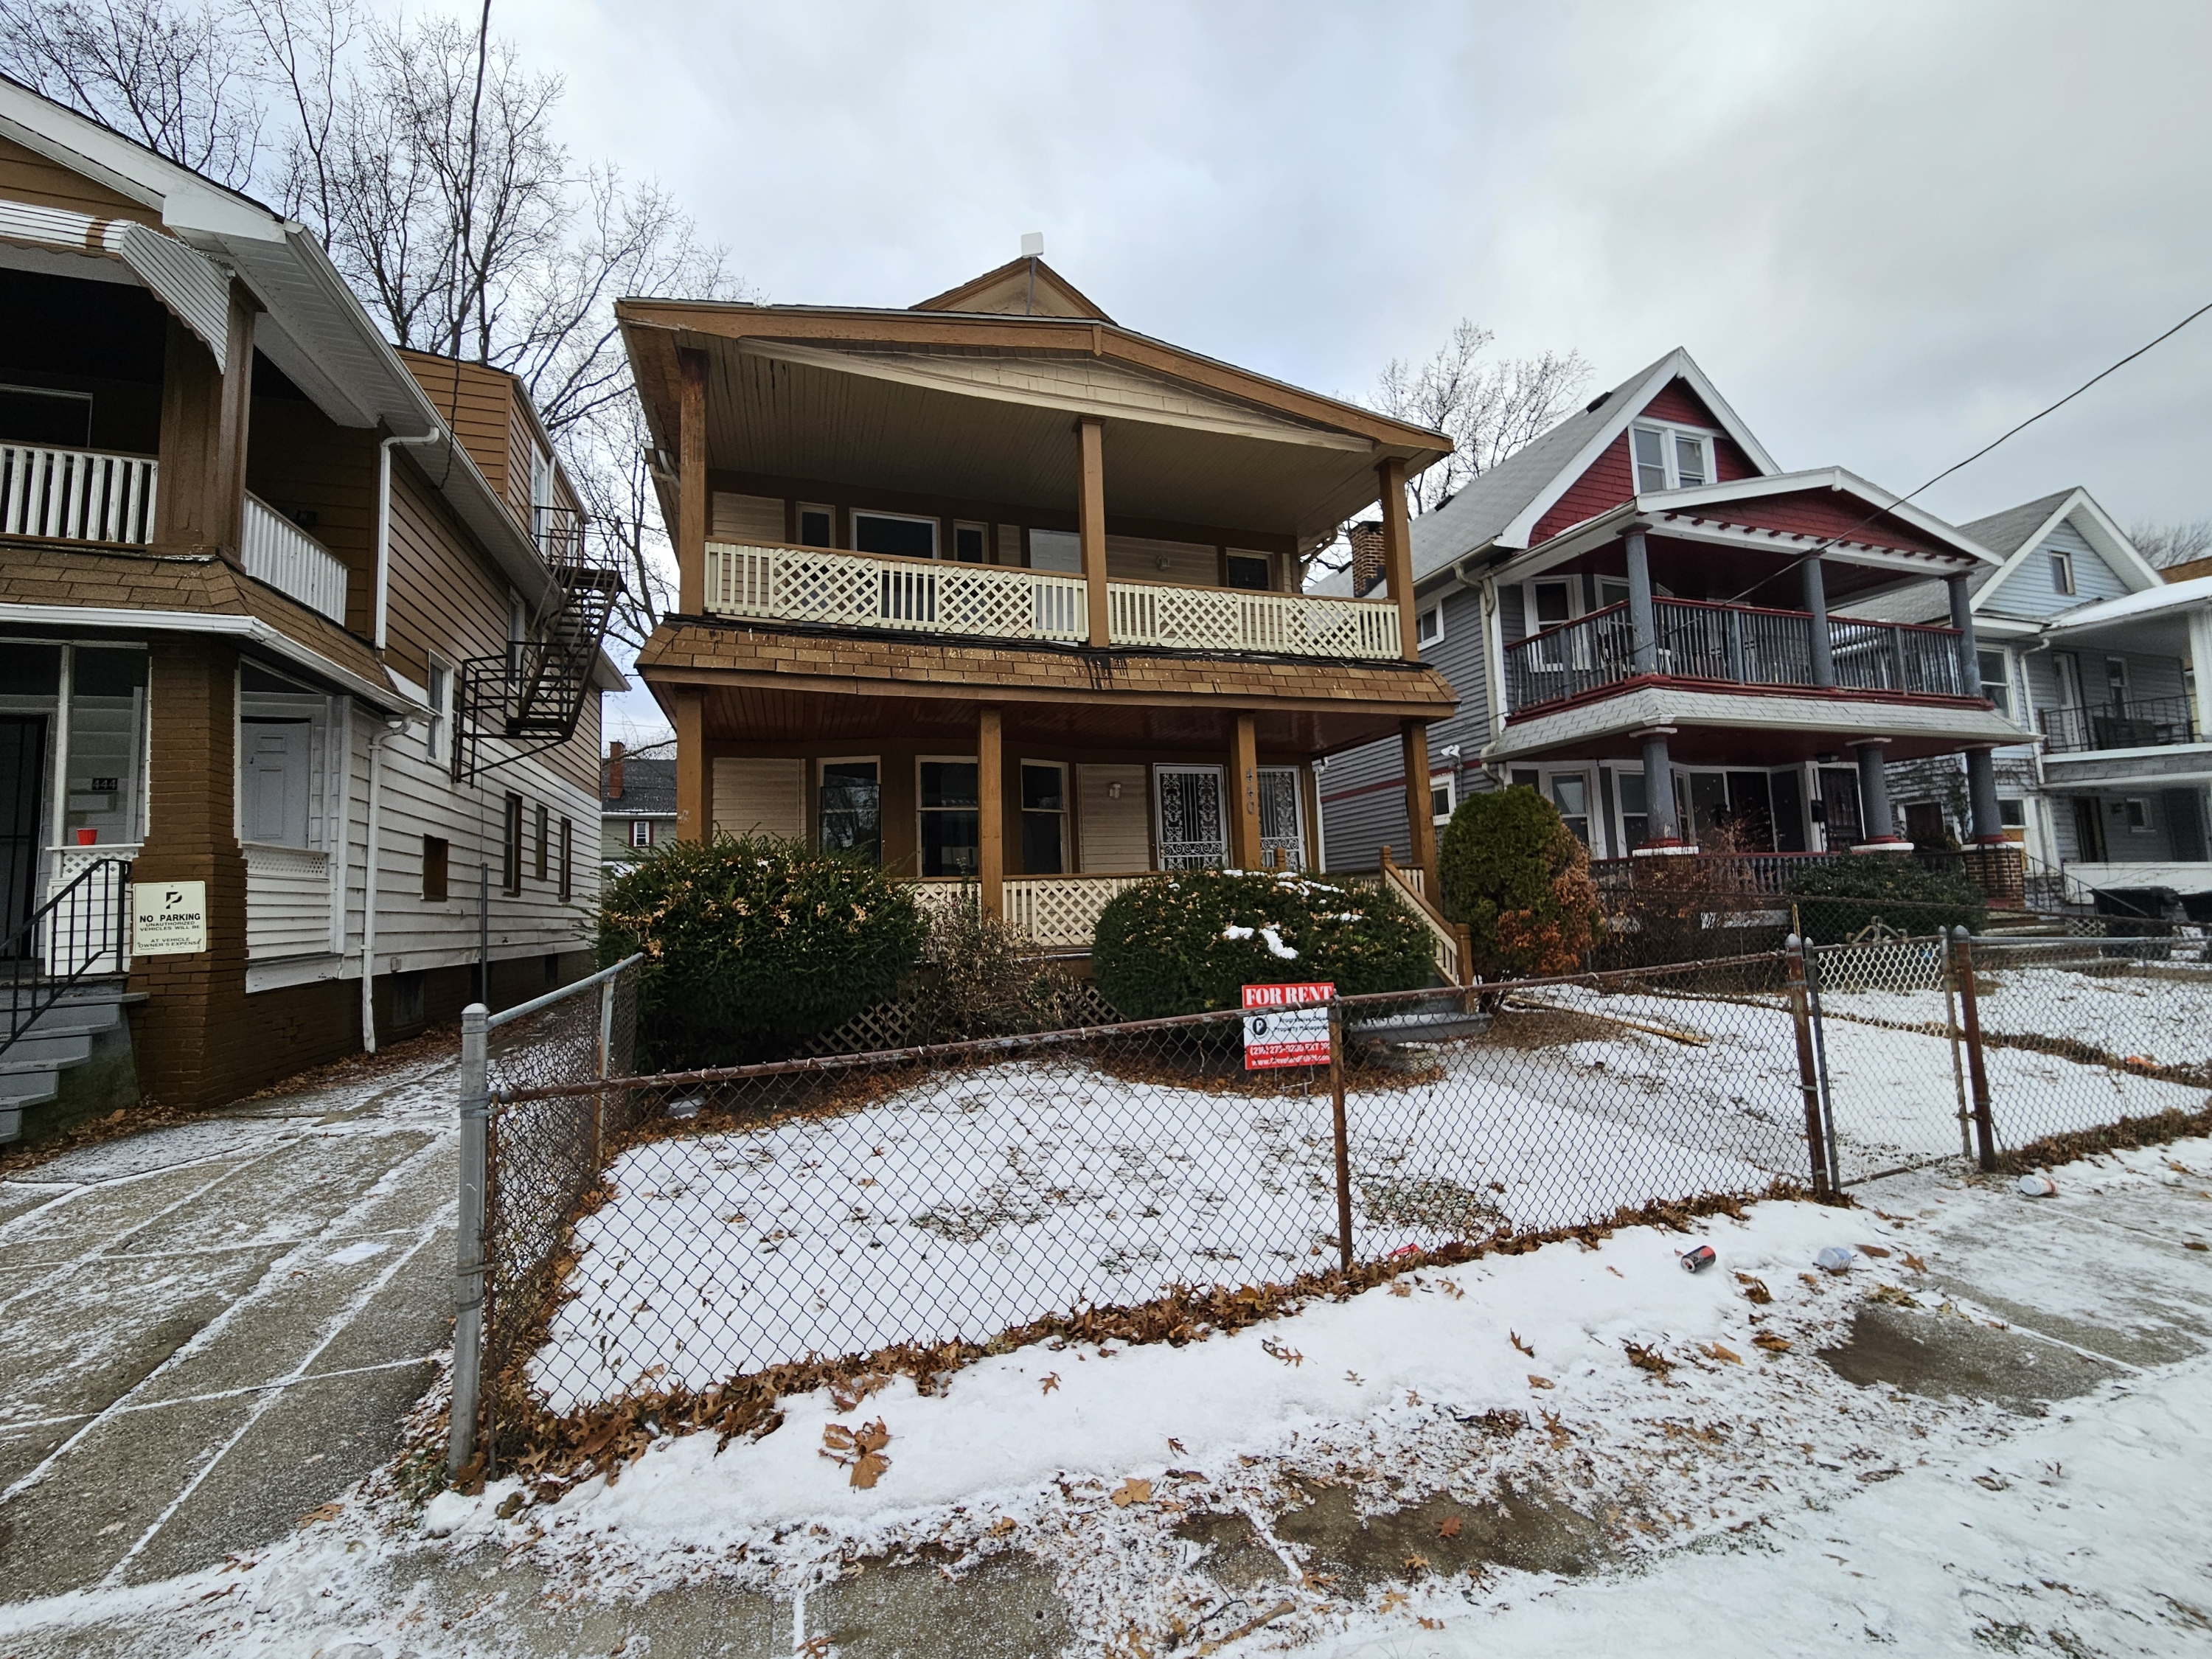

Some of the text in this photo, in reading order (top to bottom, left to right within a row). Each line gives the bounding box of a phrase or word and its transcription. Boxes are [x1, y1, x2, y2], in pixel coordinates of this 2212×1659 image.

[93, 779, 116, 789] 444
[160, 913, 201, 922] PARKING
[1246, 986, 1332, 1005] FOR RENT
